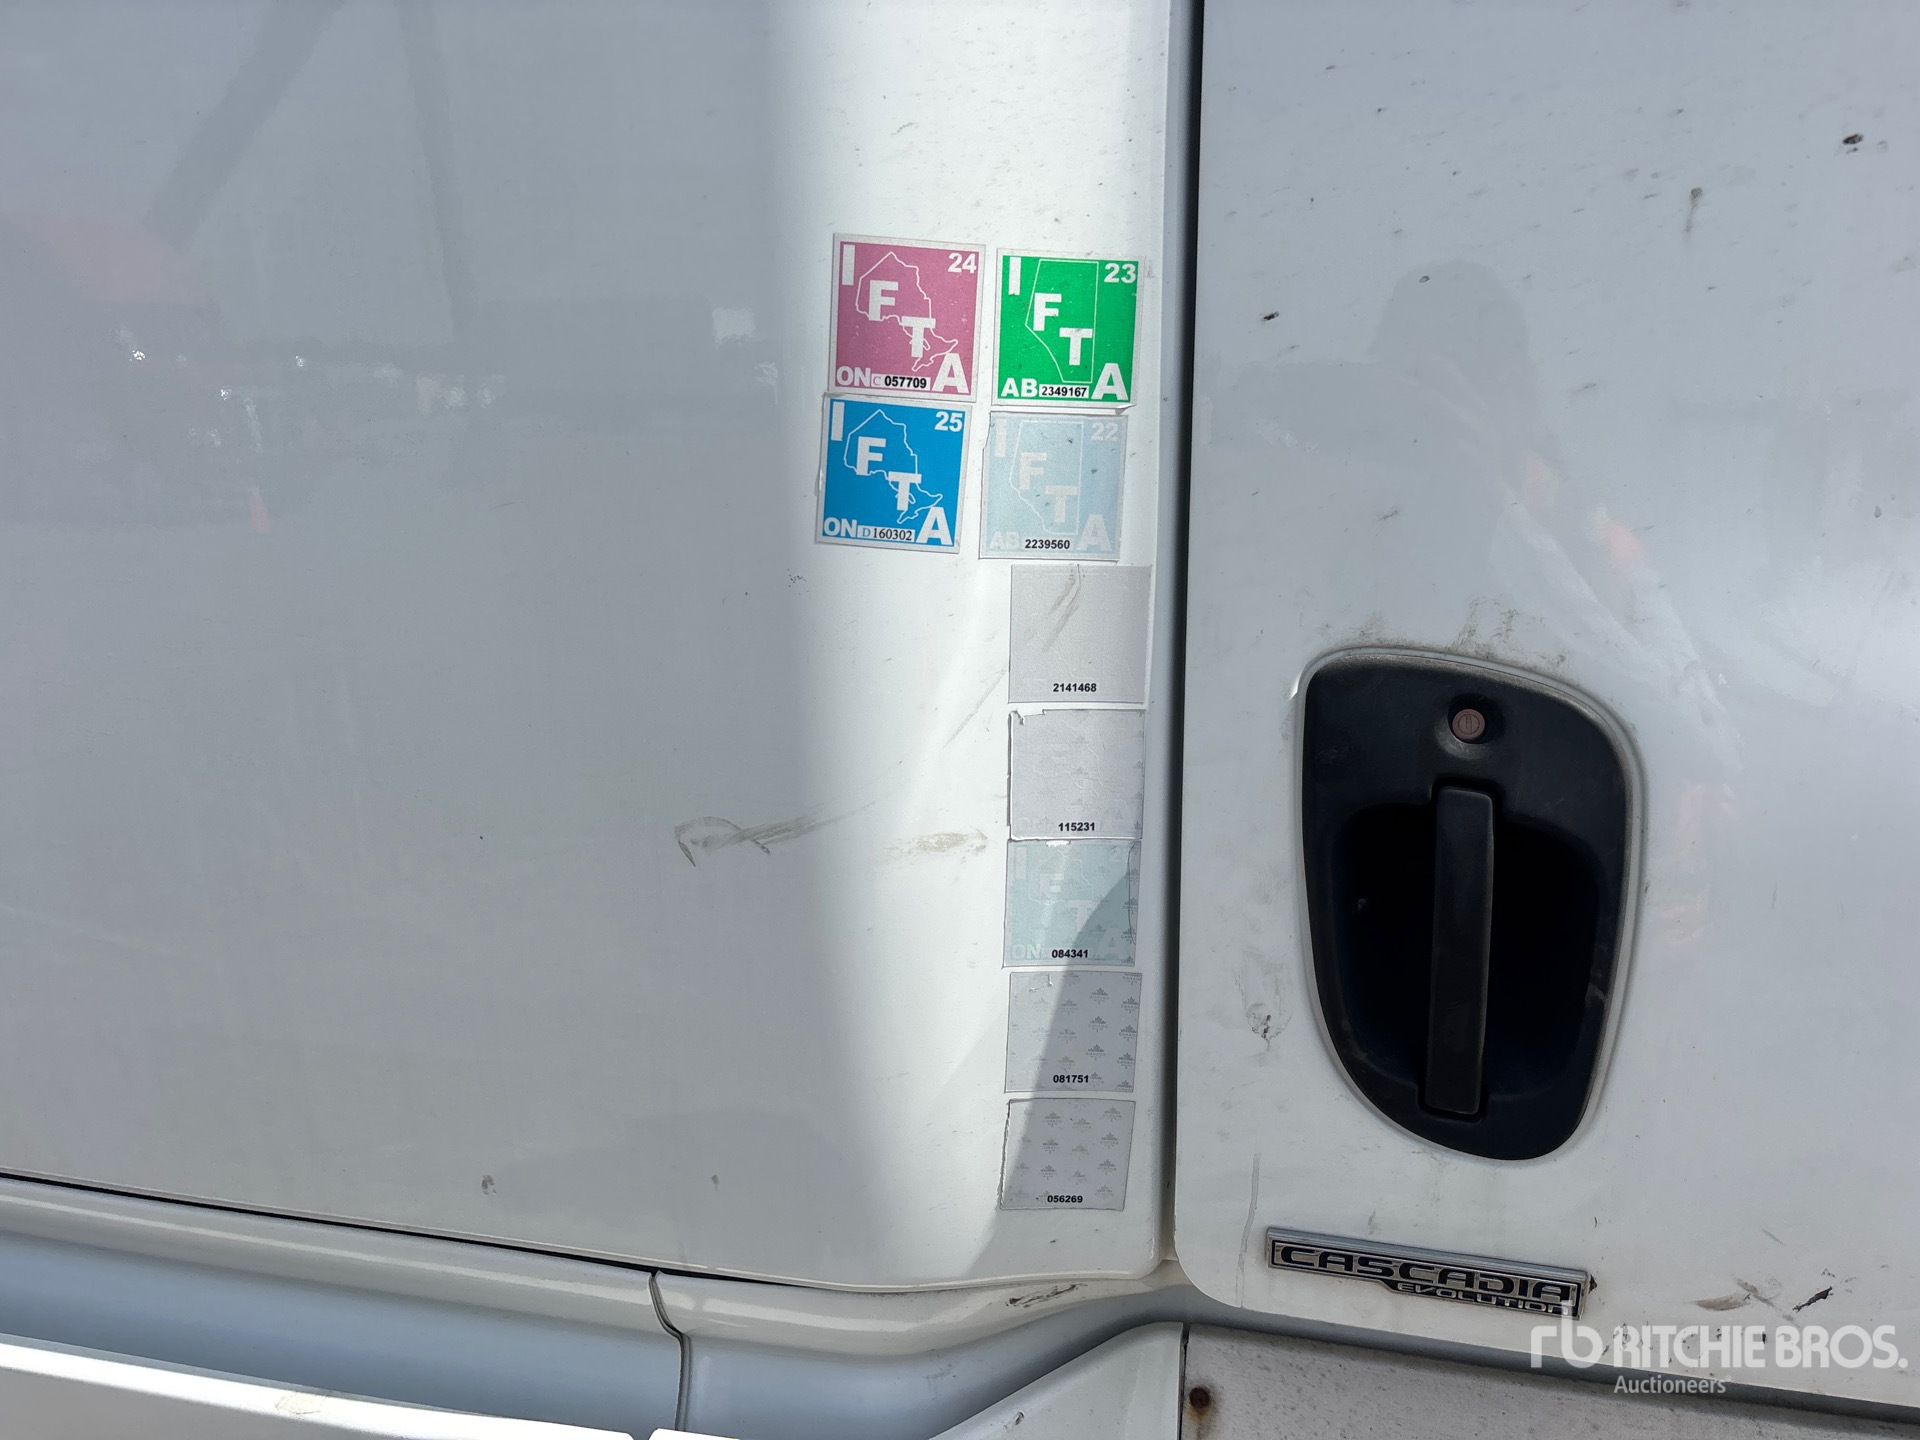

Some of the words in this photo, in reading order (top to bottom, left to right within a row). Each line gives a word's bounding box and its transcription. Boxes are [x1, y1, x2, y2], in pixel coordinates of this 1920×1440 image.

[948, 252, 977, 274] 24
[1104, 263, 1137, 284] 23
[836, 365, 871, 387] ON
[884, 375, 927, 389] 057709
[1001, 378, 1038, 398] AB
[1042, 386, 1087, 398] 2349167
[934, 411, 963, 432] 25
[1090, 421, 1119, 442] 22
[823, 516, 857, 538] ON
[873, 527, 913, 541] 160302
[1024, 538, 1071, 550] 2239560
[1053, 682, 1097, 693] 2141468
[1058, 822, 1095, 832] 115231
[1051, 949, 1088, 959] 084341
[1052, 1074, 1089, 1084] 081751
[1047, 1195, 1083, 1204] 056269
[1280, 1245, 1564, 1303] CASCADIA
[1397, 1282, 1569, 1316] EVOLUTION
